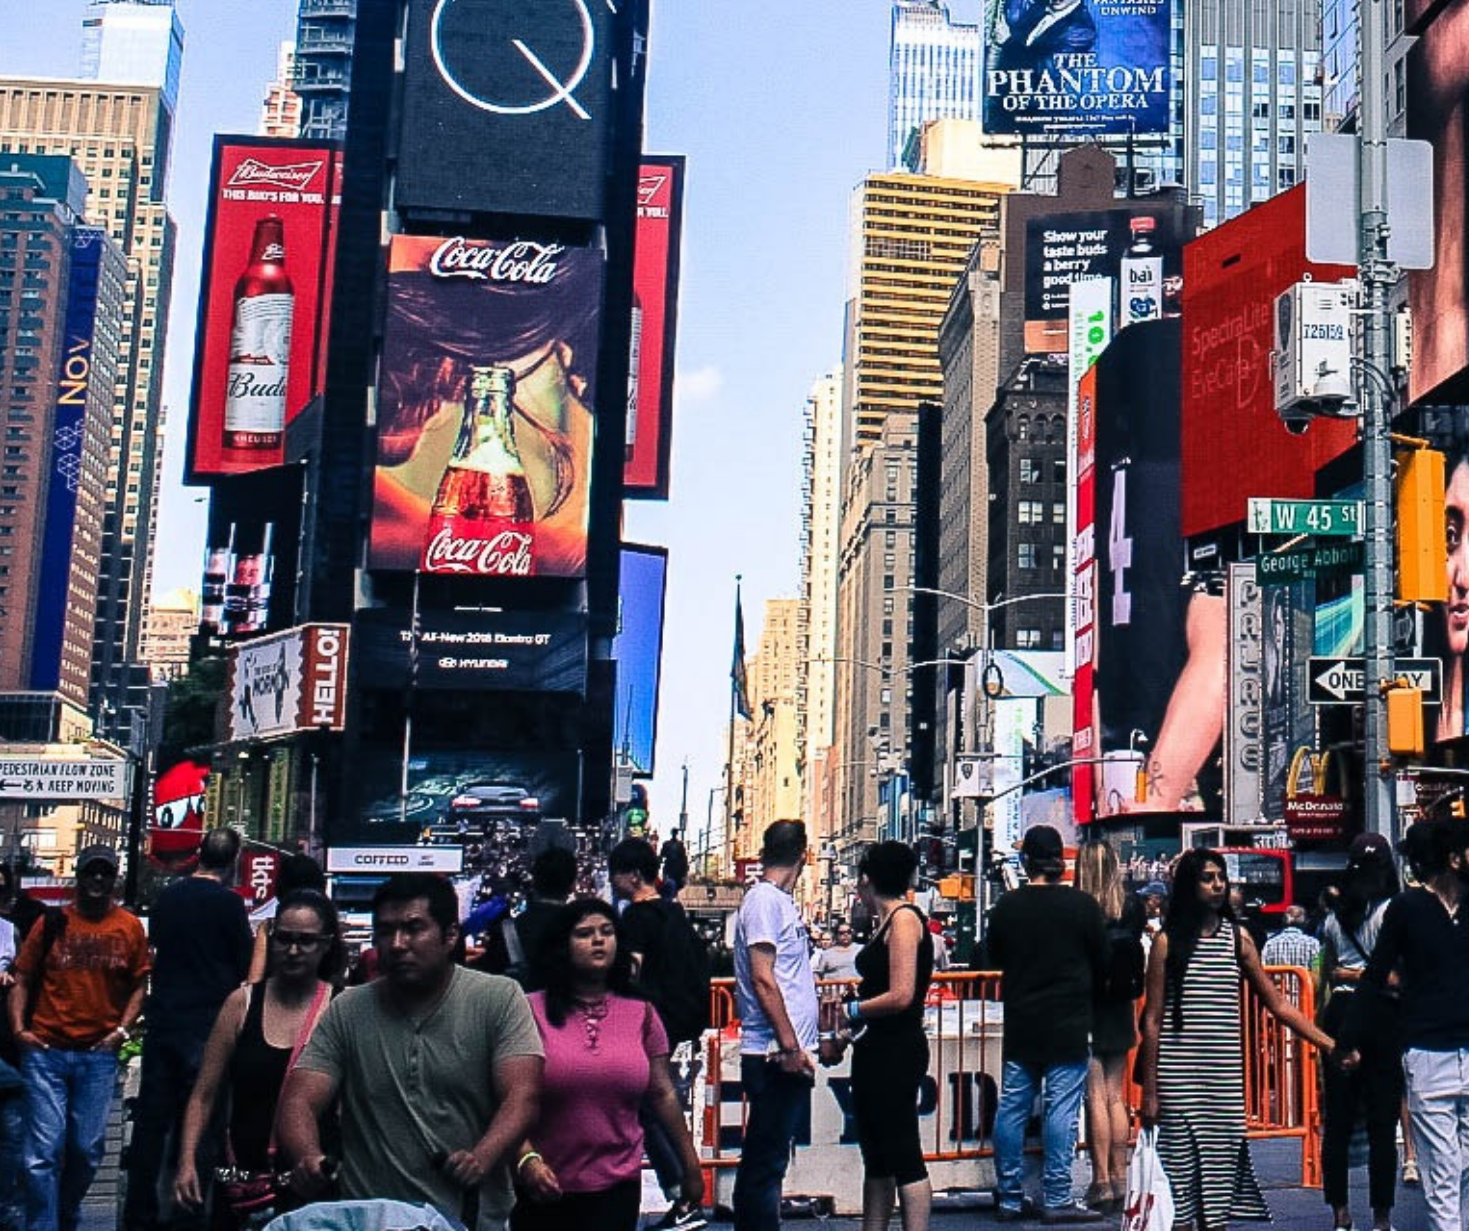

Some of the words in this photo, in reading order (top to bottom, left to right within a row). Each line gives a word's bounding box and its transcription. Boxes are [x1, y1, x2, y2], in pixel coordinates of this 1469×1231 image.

[1101, 5, 1157, 16] UNWIND
[1053, 52, 1098, 69] THE
[986, 66, 1167, 97] PHANTOM
[1002, 94, 1032, 111] OF
[1034, 94, 1077, 110] THE
[1079, 92, 1150, 110] OPERA
[222, 188, 246, 200] THIS
[279, 191, 300, 203] FOR
[1043, 230, 1077, 243] Show
[1078, 229, 1109, 243] your
[1043, 245, 1075, 258] taste
[1076, 243, 1109, 257] buds
[429, 235, 564, 285] Coca-Cola
[1043, 260, 1053, 272] a
[1053, 258, 1091, 272] berry
[1043, 272, 1073, 289] good
[1129, 265, 1153, 283] bai
[1276, 504, 1296, 530] W
[1306, 504, 1332, 531] 45
[1341, 506, 1357, 522] St
[426, 526, 535, 576] Coca-Cola
[1261, 552, 1309, 574] George
[421, 631, 466, 643] All-New
[534, 634, 552, 645] GT
[458, 658, 510, 669] HYUNDAI
[1240, 579, 1259, 773] PALACE
[1328, 671, 1365, 689] ONE
[58, 763, 88, 777] FLOW
[90, 764, 116, 778] ZONE
[48, 780, 74, 793] KEEP
[75, 780, 116, 794] MOVING
[1286, 801, 1350, 811] McDonald
[354, 854, 410, 866] COFFEED
[252, 855, 275, 900] tkts
